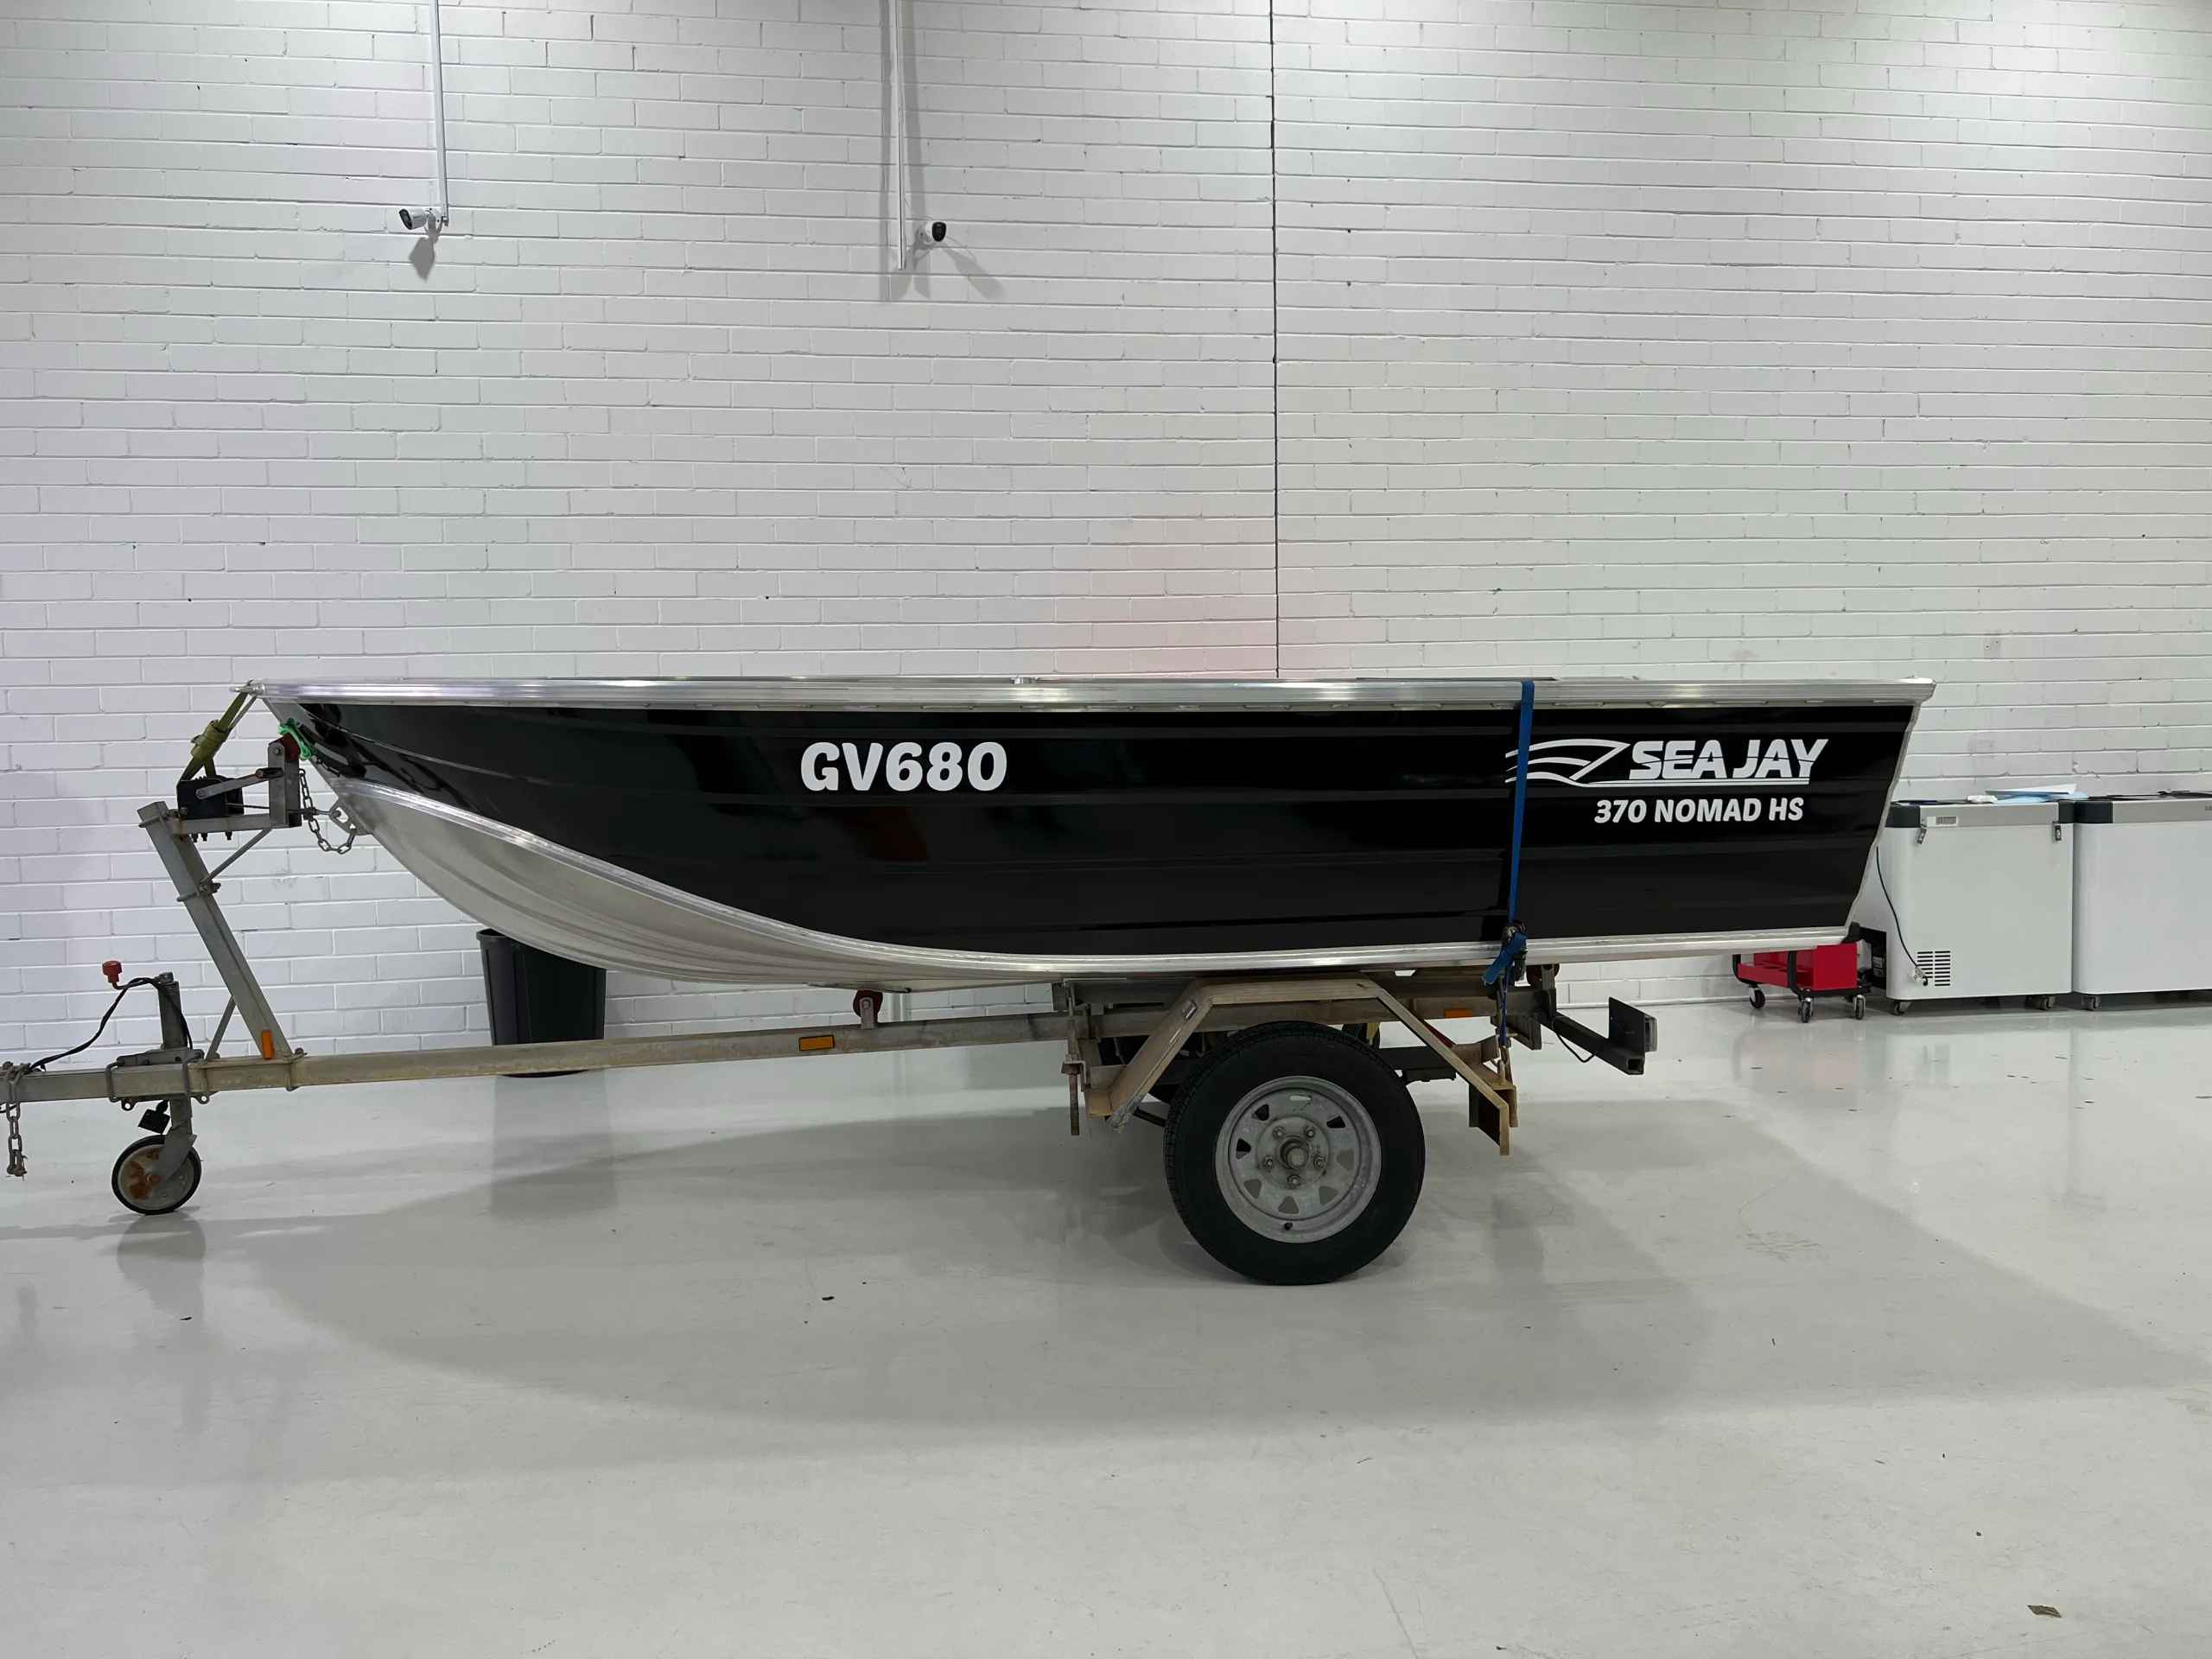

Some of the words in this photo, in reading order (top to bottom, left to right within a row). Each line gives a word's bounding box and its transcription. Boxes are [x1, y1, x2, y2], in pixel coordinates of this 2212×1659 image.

[800, 741, 1007, 791] GV680
[1629, 740, 1727, 779] SEA
[1731, 739, 1829, 779] JAY
[1593, 799, 1647, 823] 370
[1654, 798, 1762, 823] NOMAD
[1768, 797, 1804, 821] HS
